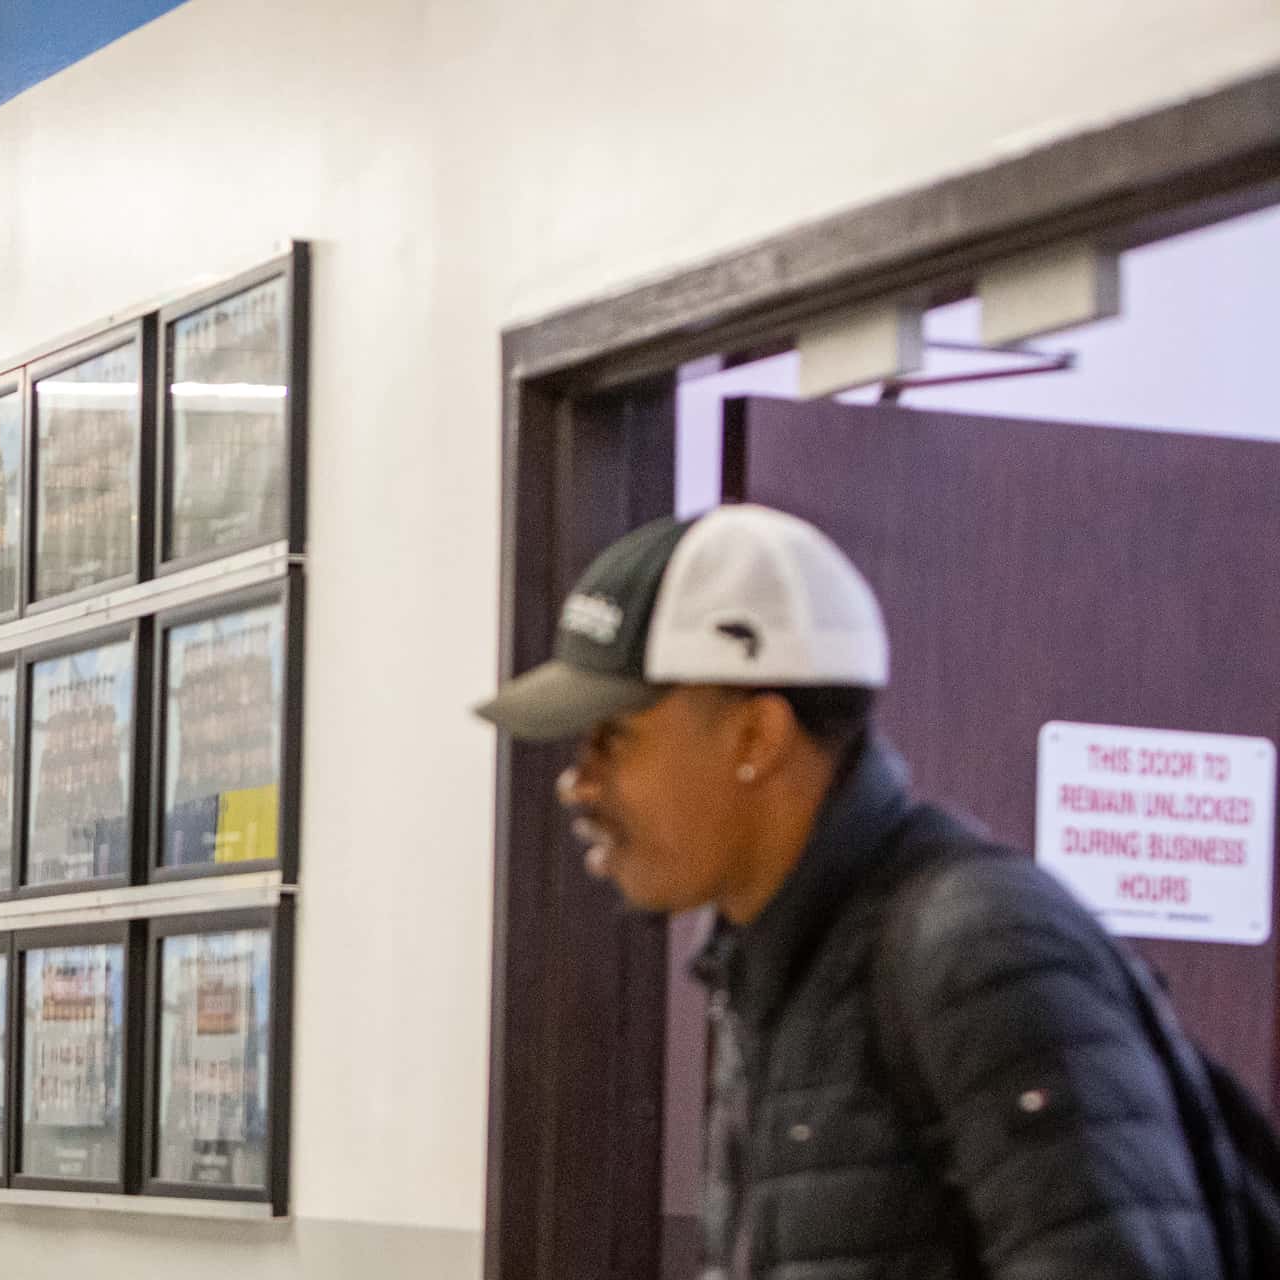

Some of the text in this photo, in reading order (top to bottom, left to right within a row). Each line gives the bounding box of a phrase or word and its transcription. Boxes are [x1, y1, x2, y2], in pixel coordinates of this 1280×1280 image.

[1087, 743, 1229, 782] THIS DOOR TO
[1058, 783, 1251, 826] REMAIN UNLOCKED
[1063, 826, 1247, 867] DURING BUSINESS
[1117, 874, 1190, 904] HOURS
